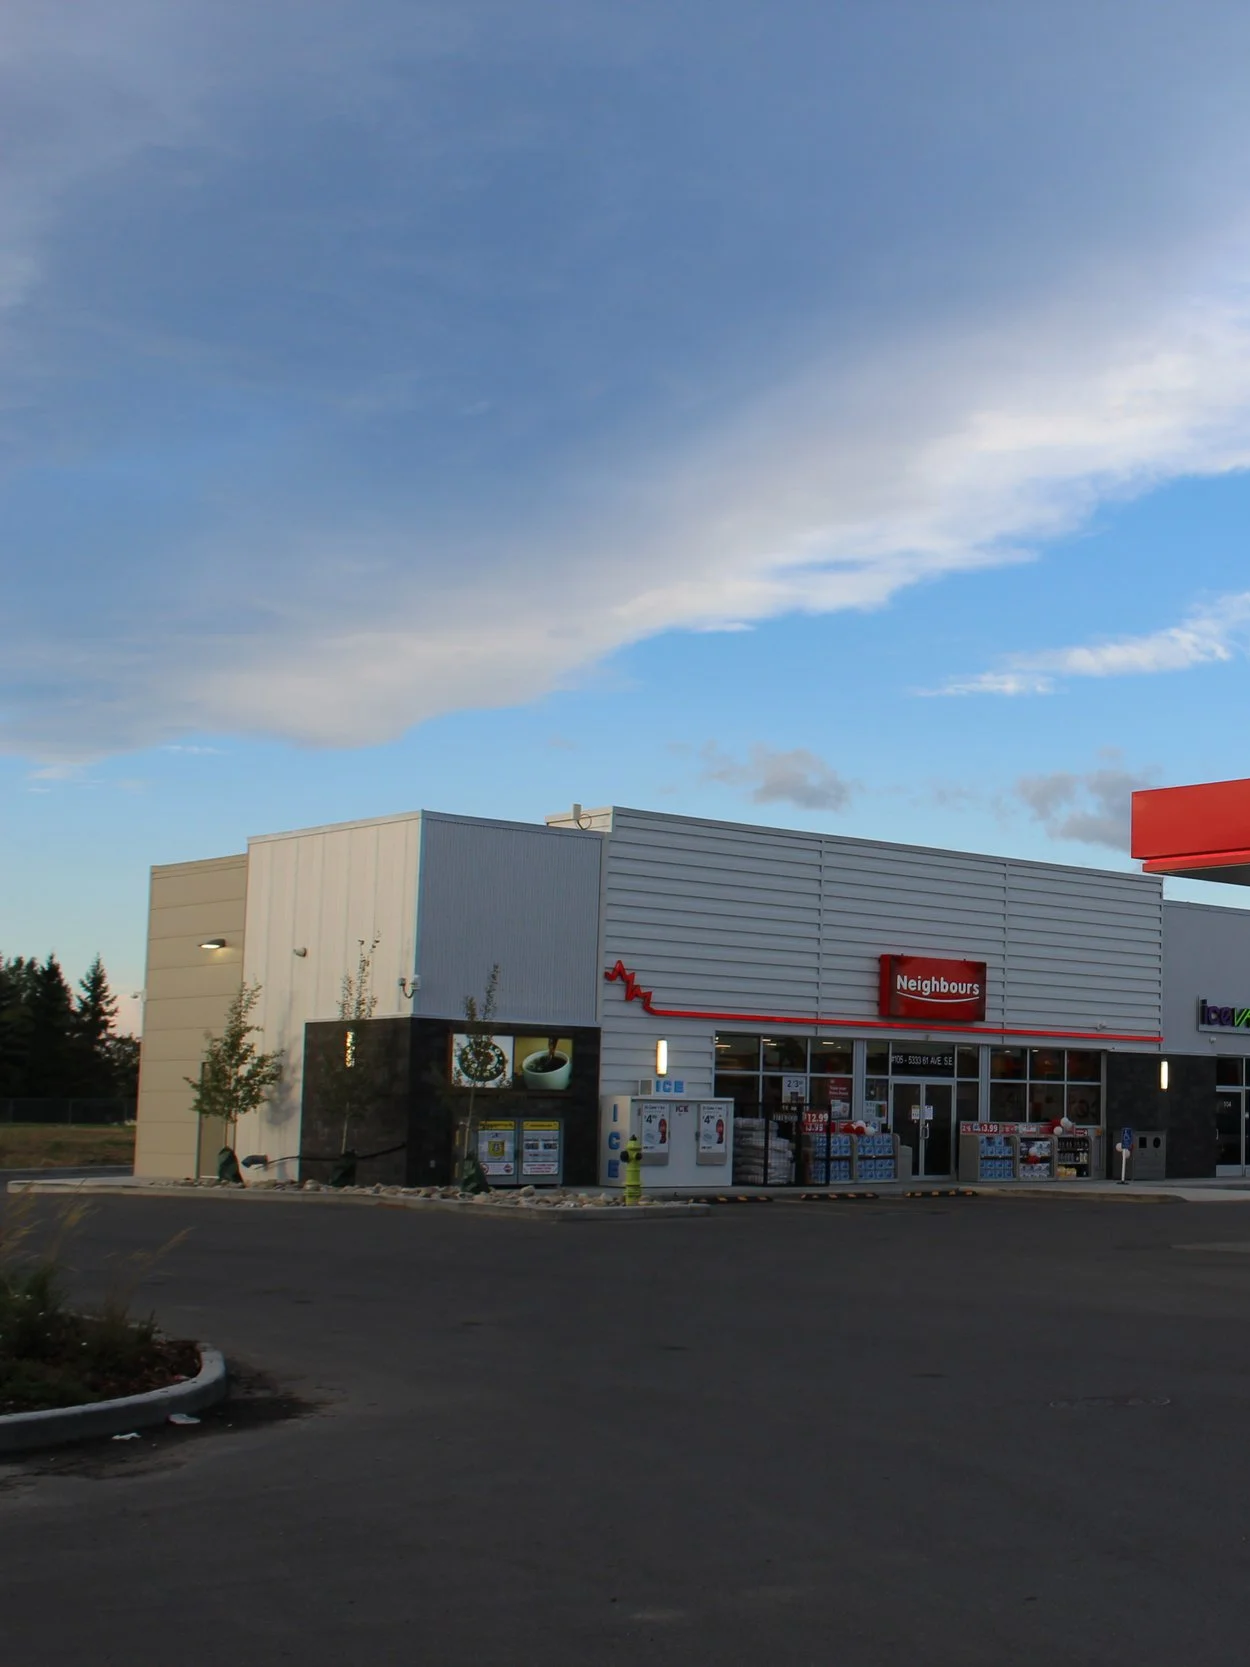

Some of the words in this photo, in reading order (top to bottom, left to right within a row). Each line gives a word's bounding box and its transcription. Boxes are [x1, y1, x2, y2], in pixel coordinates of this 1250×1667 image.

[896, 974, 980, 996] Neighbours
[930, 1056, 942, 1066] AVE
[655, 1080, 685, 1093] ICE
[675, 1105, 689, 1113] ICE
[608, 1104, 621, 1179] ICE
